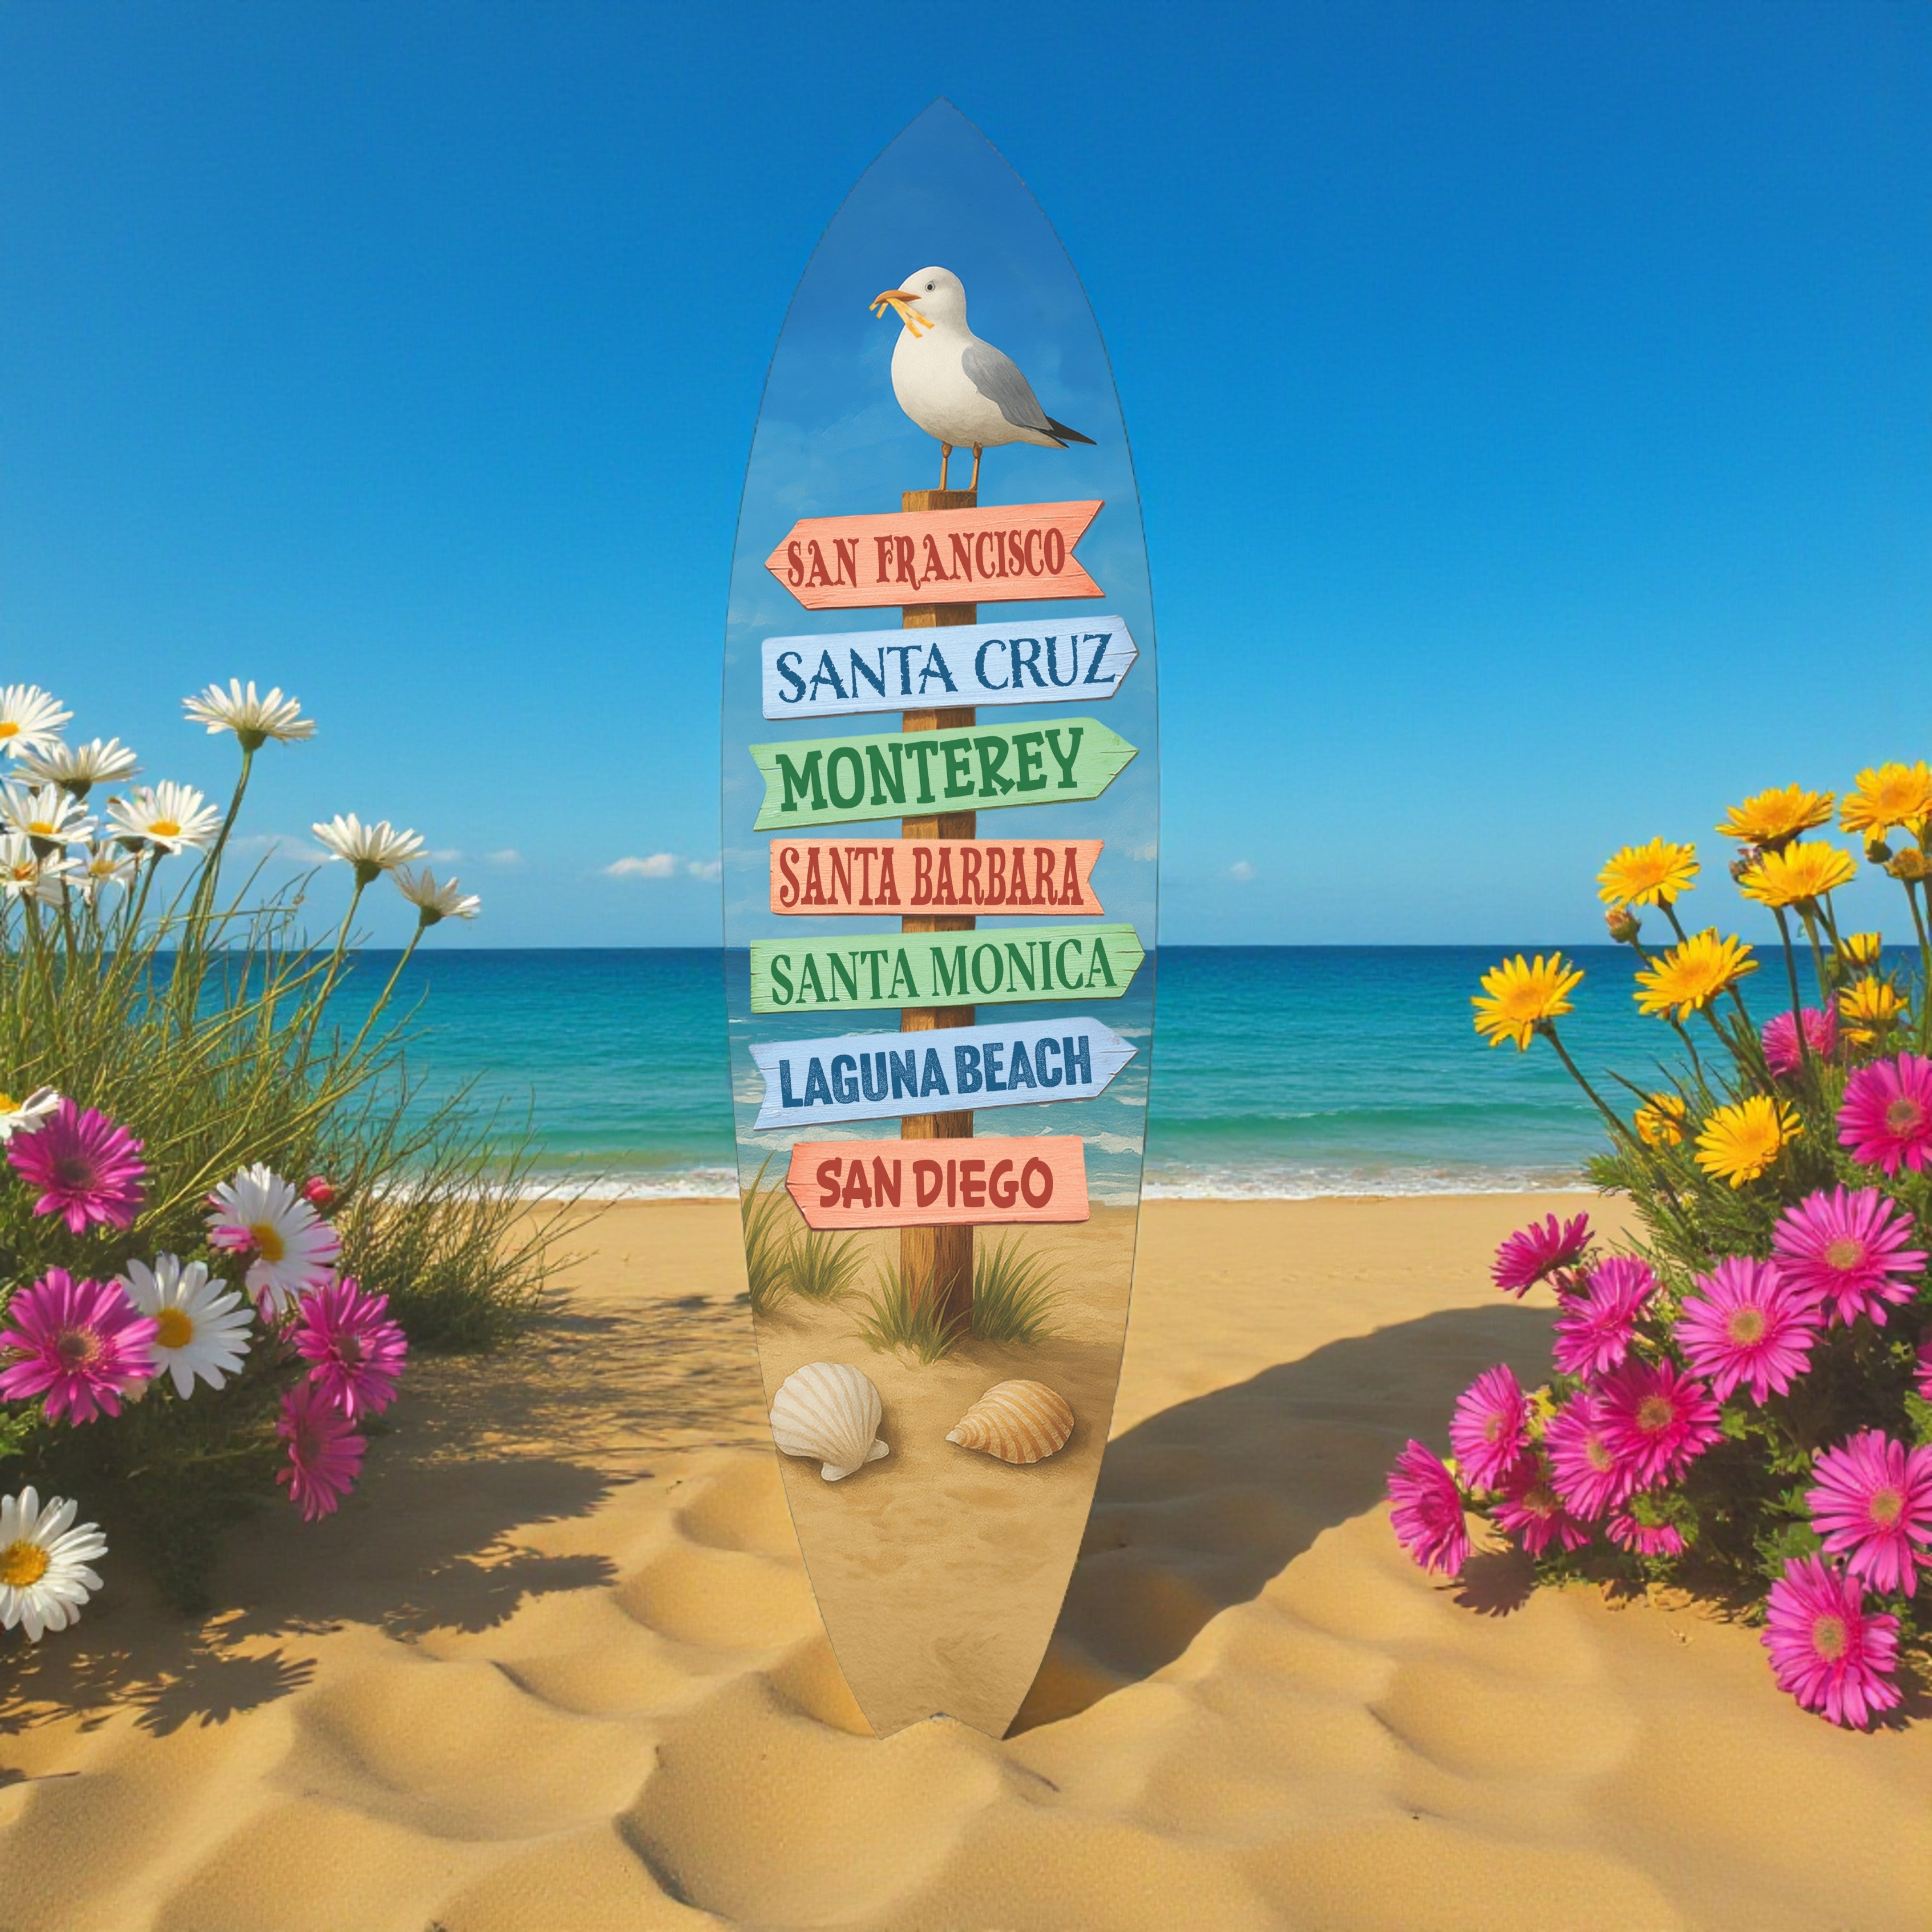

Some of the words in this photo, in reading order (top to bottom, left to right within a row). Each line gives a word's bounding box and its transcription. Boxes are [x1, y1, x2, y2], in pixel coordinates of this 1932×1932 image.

[787, 538, 859, 588] SAN
[874, 527, 1066, 591] FRANCISCO
[776, 643, 958, 703] SANTA
[975, 633, 1116, 690] CRUZ
[775, 727, 1084, 812] MONTEREY
[780, 847, 901, 908] SANTA
[910, 847, 1084, 906] BARBARA
[770, 948, 920, 1005] SANTA
[930, 937, 1117, 997] MONICA
[779, 1048, 950, 1108] LAGUNA
[955, 1035, 1092, 1095] BEACH
[816, 1156, 901, 1209] SAN
[912, 1156, 1054, 1209] DIEGO
